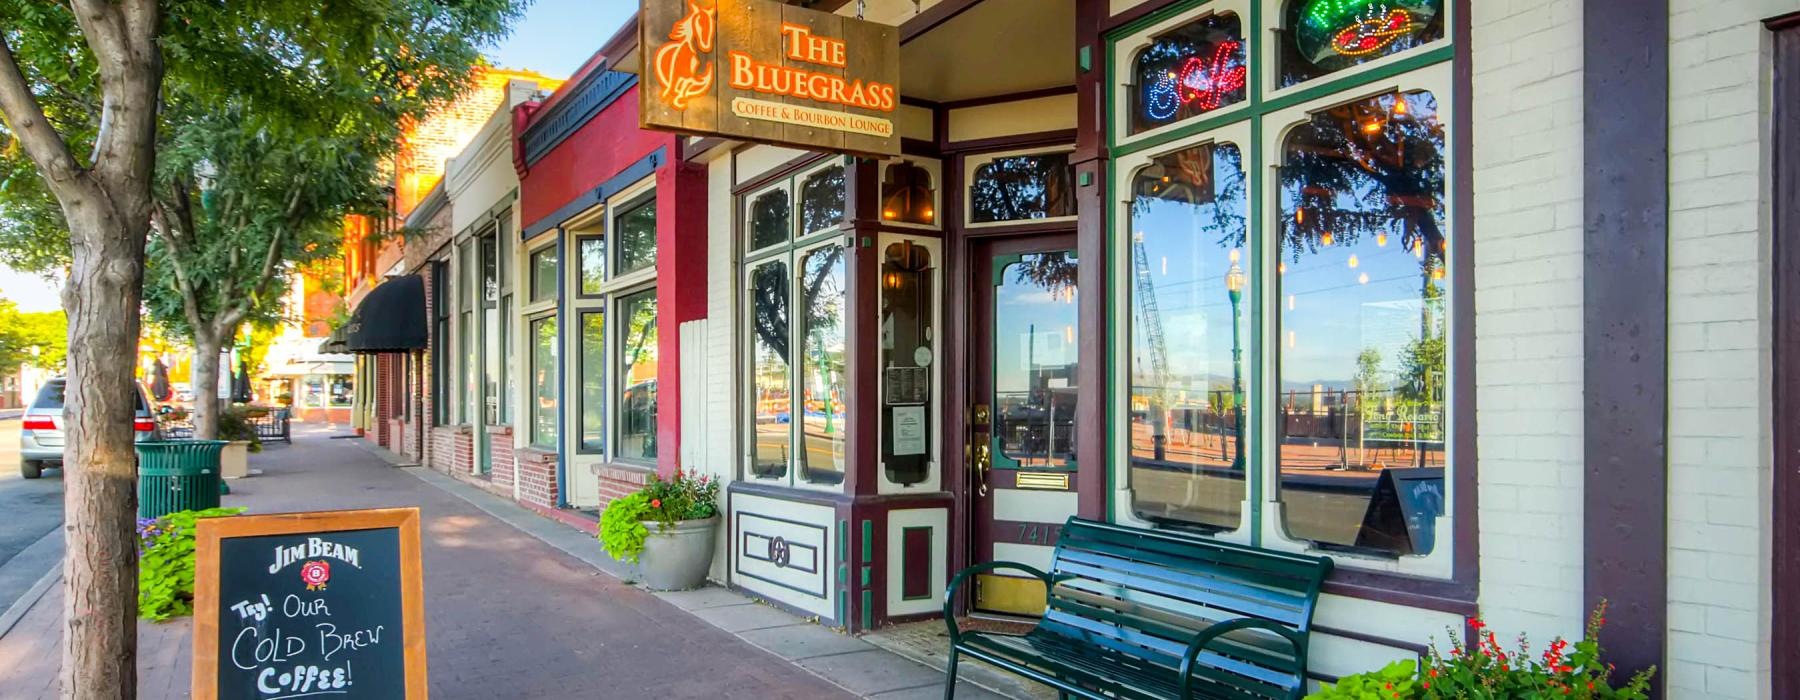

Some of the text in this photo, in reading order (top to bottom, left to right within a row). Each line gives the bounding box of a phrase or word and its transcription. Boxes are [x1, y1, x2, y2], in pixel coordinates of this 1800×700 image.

[782, 24, 846, 65] THE
[731, 53, 893, 109] BLUEGRASS
[736, 101, 891, 135] COFFEE & BOURBON LOUNGE
[269, 537, 359, 574] JIM BEAM
[230, 594, 273, 621] Try!
